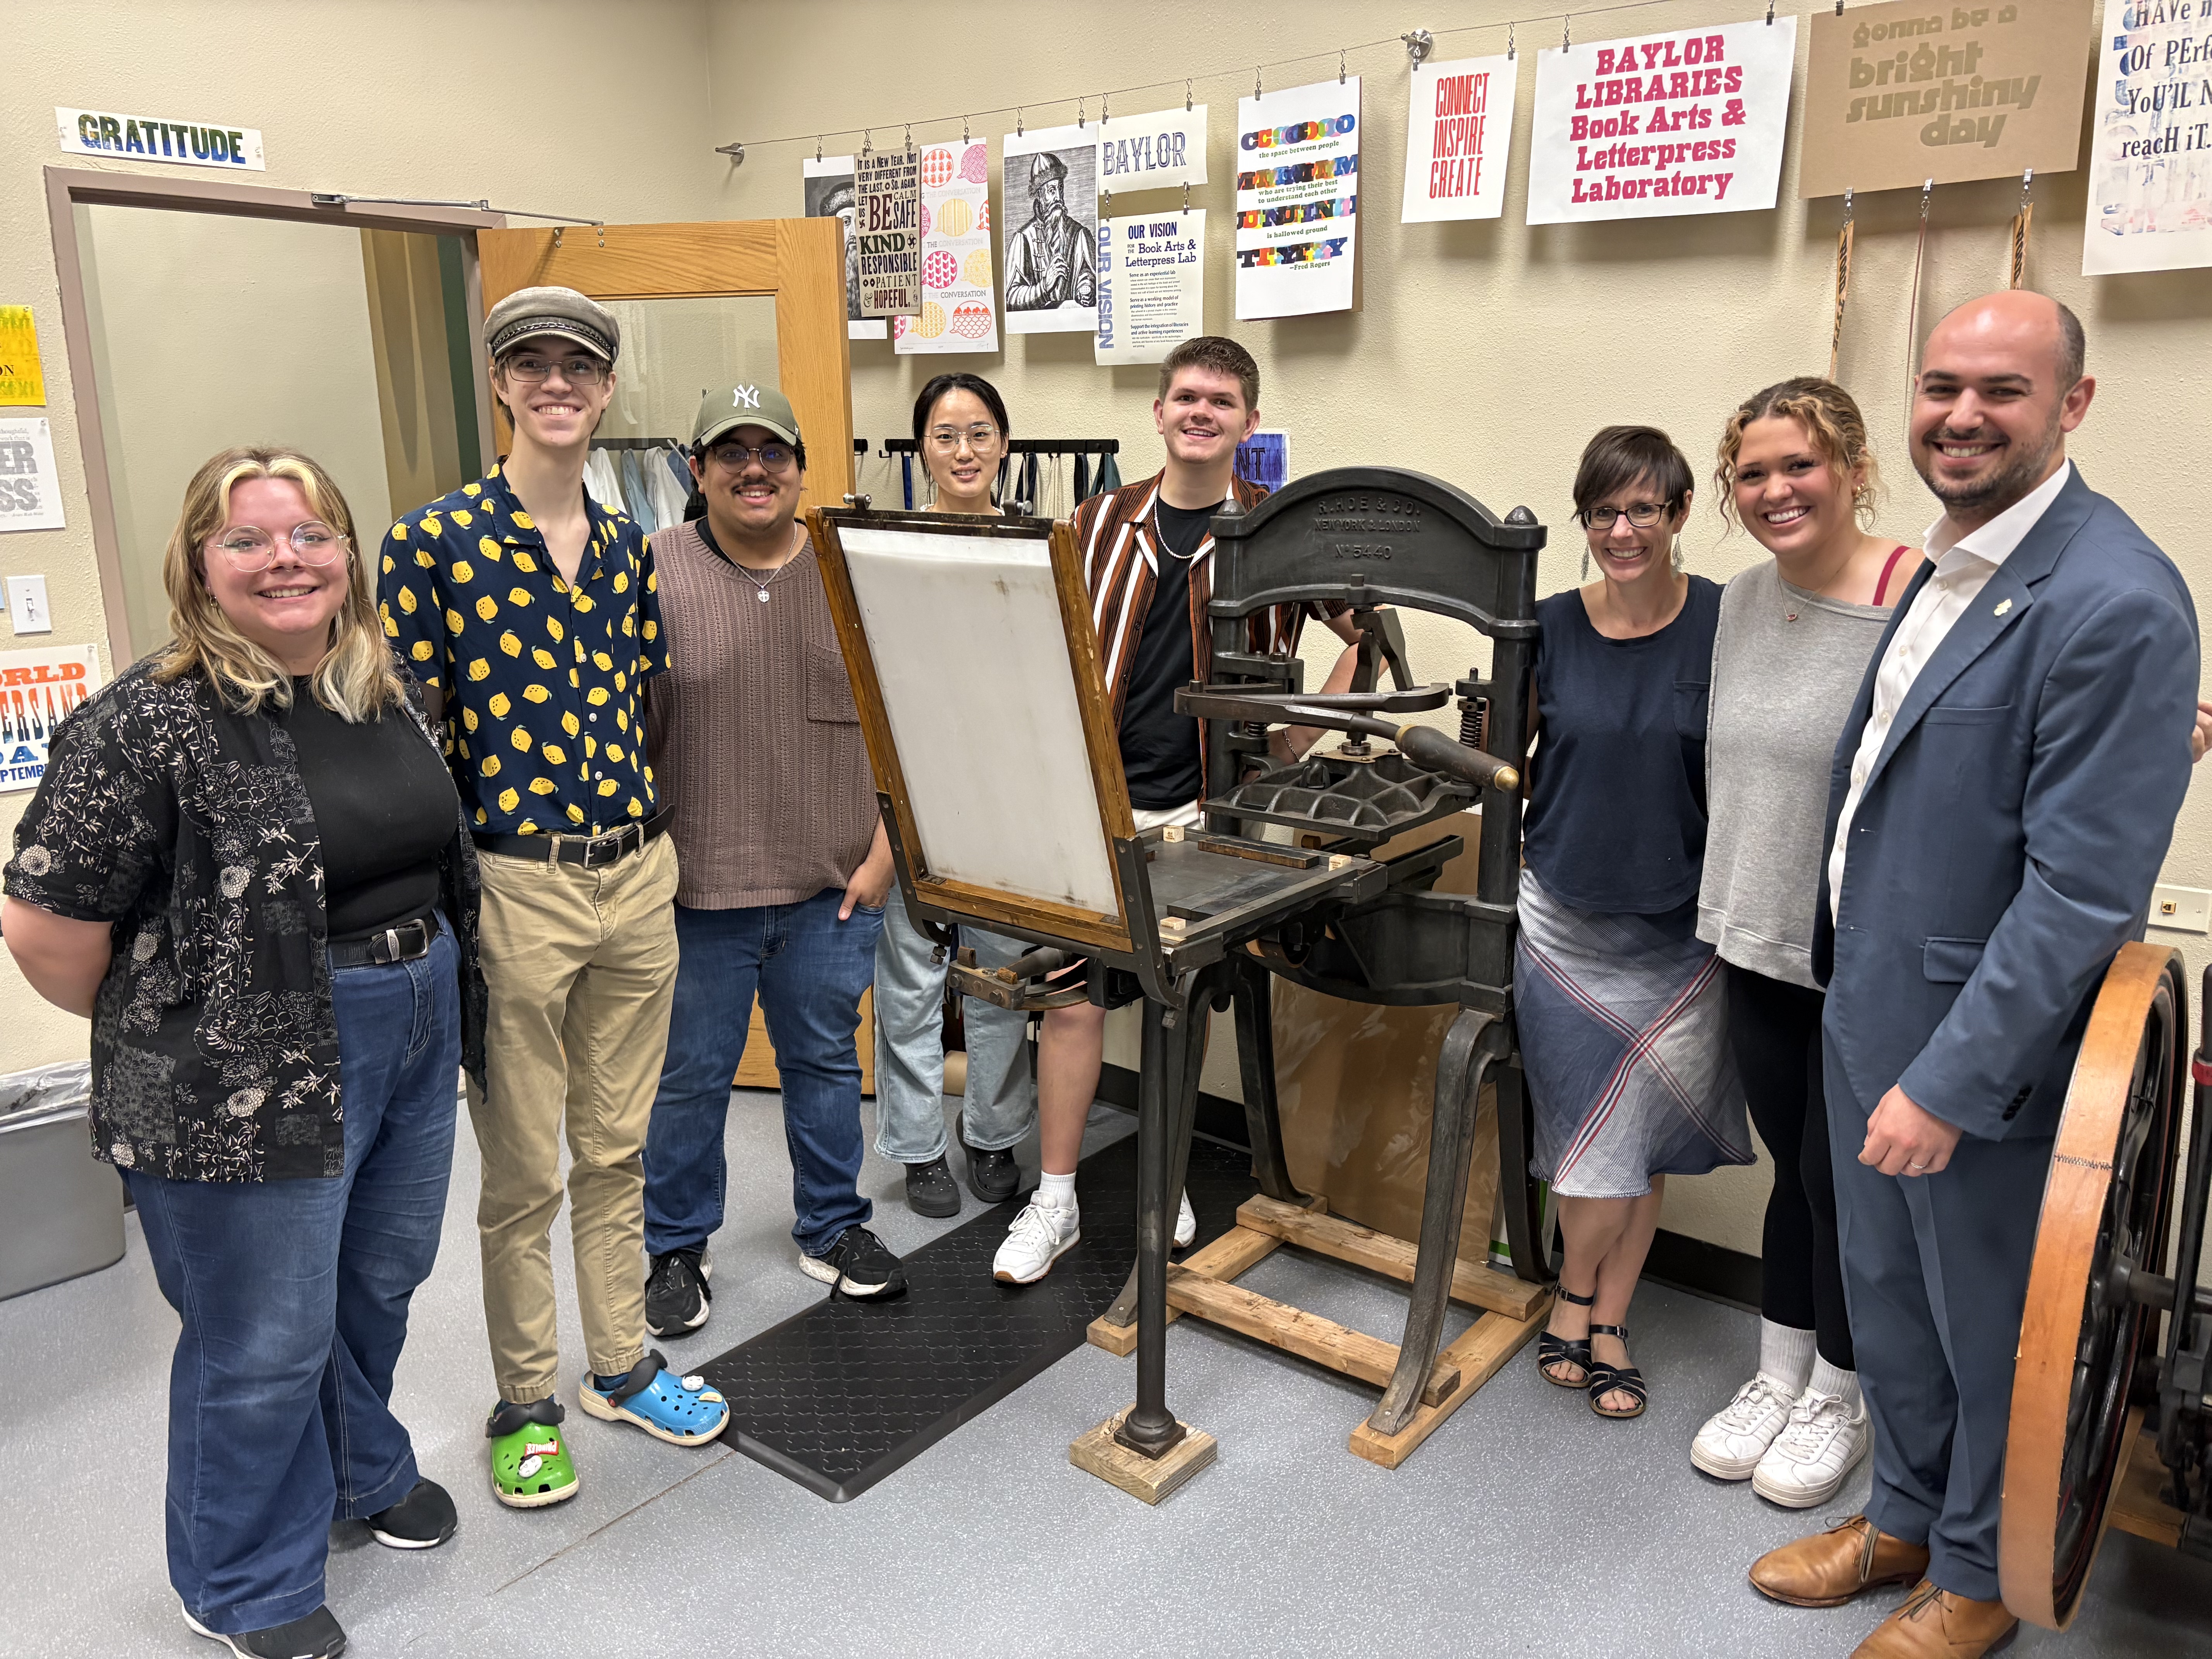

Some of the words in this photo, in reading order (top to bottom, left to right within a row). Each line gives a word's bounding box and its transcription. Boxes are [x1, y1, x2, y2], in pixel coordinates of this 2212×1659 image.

[1853, 15, 1942, 48] gonna
[1951, 7, 1989, 30] be
[1997, 4, 2018, 23] a
[1595, 34, 1724, 76] BAYLOR
[2131, 43, 2155, 71] Of
[2164, 34, 2212, 66] PErf
[1849, 41, 1984, 89] bright
[1435, 72, 1490, 118] CONNECT
[1575, 65, 1743, 110] LIBRARIES
[1846, 75, 2042, 123] sunshiny
[1570, 110, 1640, 141] Book
[1646, 103, 1712, 133] Arts
[1721, 98, 1747, 126] &
[1920, 113, 2008, 148] day
[78, 114, 246, 165] GRATITUDE
[1290, 146, 1316, 154] between
[1318, 141, 1339, 150] people
[1433, 115, 1486, 158] INSPIRE
[2121, 126, 2180, 158] reacH
[2186, 123, 2211, 151] iT.
[865, 160, 869, 170] IS
[877, 156, 889, 168] NEW
[907, 152, 917, 164] NOT
[1103, 132, 1187, 176] BAYLOR
[1576, 138, 1736, 171] Letterpress
[858, 171, 872, 182] VERY
[875, 168, 901, 180] DIFFERENT
[903, 165, 916, 177] FROM
[1429, 157, 1483, 199] CREATE
[858, 184, 868, 194] THE
[869, 182, 884, 193] LAST.
[894, 190, 916, 200] CALM
[1267, 193, 1303, 203] understand
[1571, 170, 1733, 203] Laboratory
[858, 196, 867, 206] LET
[859, 208, 865, 218] US
[869, 193, 892, 231] BE
[893, 199, 916, 229] SAFE
[1128, 225, 1145, 239] OUR
[1149, 222, 1177, 238] VISION
[1274, 228, 1304, 237] hallowed
[1305, 225, 1328, 235] ground
[859, 233, 905, 255] KIND
[1097, 226, 1111, 273] OUR
[1139, 242, 1162, 254] Book
[1164, 241, 1185, 252] Arts
[1187, 239, 1196, 250] &
[861, 252, 917, 275] RESPONSIBLE
[1125, 256, 1175, 267] Letterpress
[1178, 252, 1196, 263] Lab
[876, 274, 917, 288] PATIENT
[874, 288, 910, 309] HOPEFUL.
[941, 290, 986, 298] CONVERSATION
[1098, 278, 1114, 349] VISION
[733, 385, 761, 408] NY
[1338, 519, 1366, 531] YORK
[1379, 520, 1420, 532] LONDON
[1353, 545, 1392, 558] 5440
[0, 663, 86, 687] RLD
